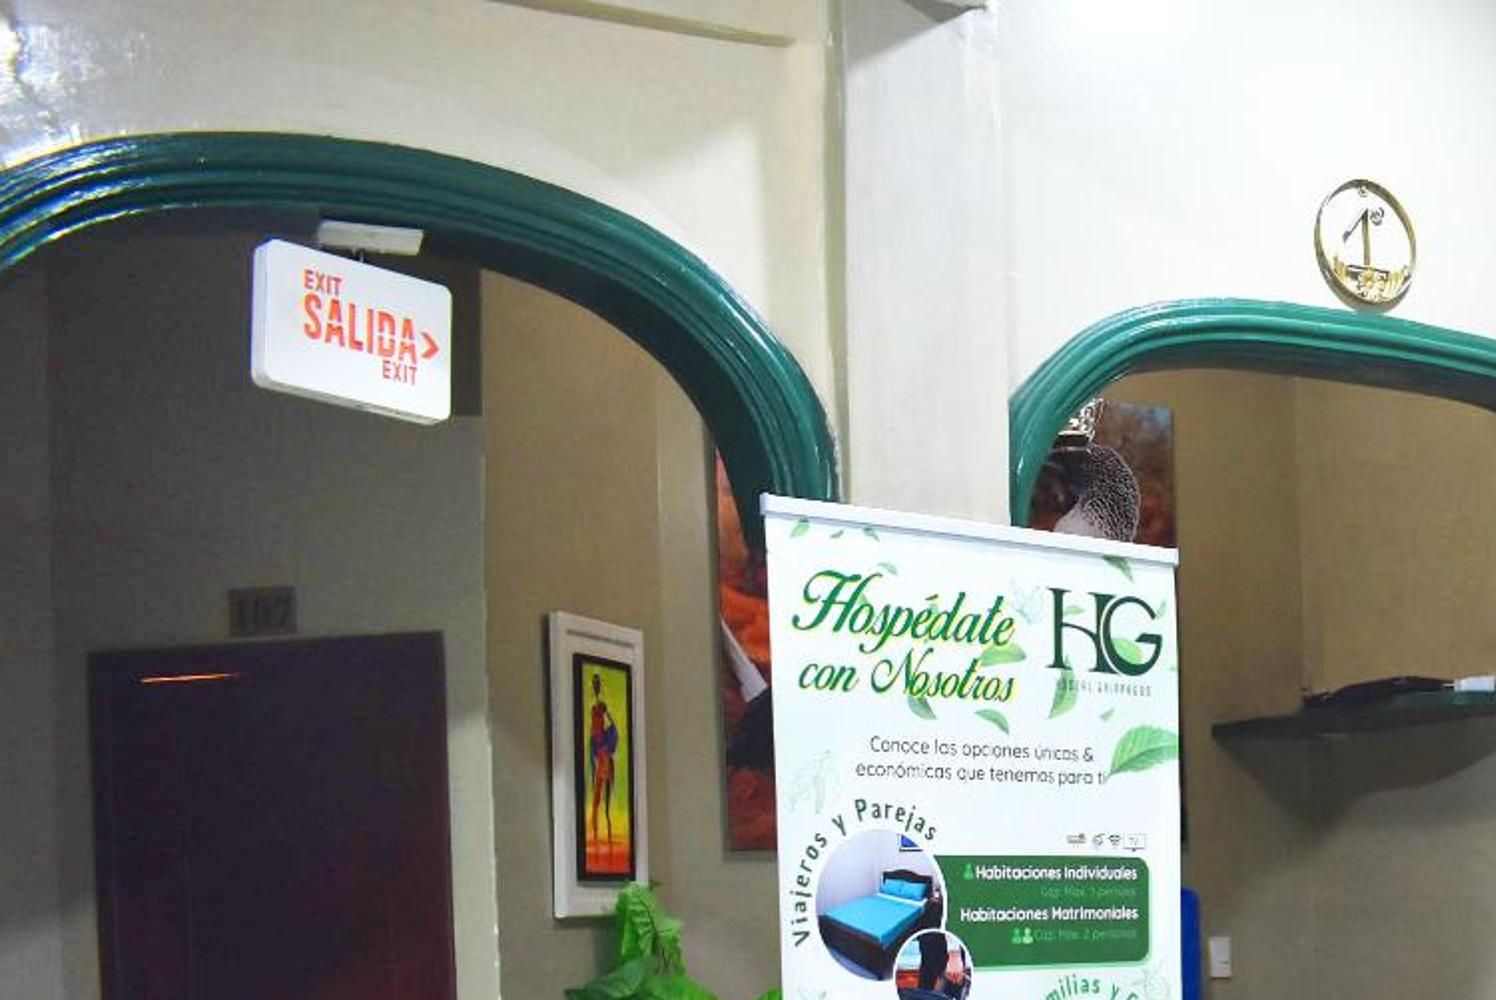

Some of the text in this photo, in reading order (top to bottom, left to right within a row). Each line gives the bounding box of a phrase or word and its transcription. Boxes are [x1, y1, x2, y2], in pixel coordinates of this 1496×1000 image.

[304, 269, 342, 296] EXIT
[304, 292, 417, 364] SALIDA
[382, 359, 418, 386] EXIT
[791, 570, 1016, 653] Hospédate
[1046, 587, 1163, 677] HG
[798, 648, 1017, 702] con Nosotros
[869, 735, 1095, 762] Conoce las opciones únicas &
[855, 761, 953, 781] económicas
[956, 766, 986, 785] que
[990, 766, 1055, 785] tenemos
[1058, 773, 1094, 788] para
[790, 798, 938, 947] Viajeros y Parejas
[976, 863, 1139, 881] Habitaciones Individuales
[960, 905, 1140, 922] Habitaciones Matrimoniales
